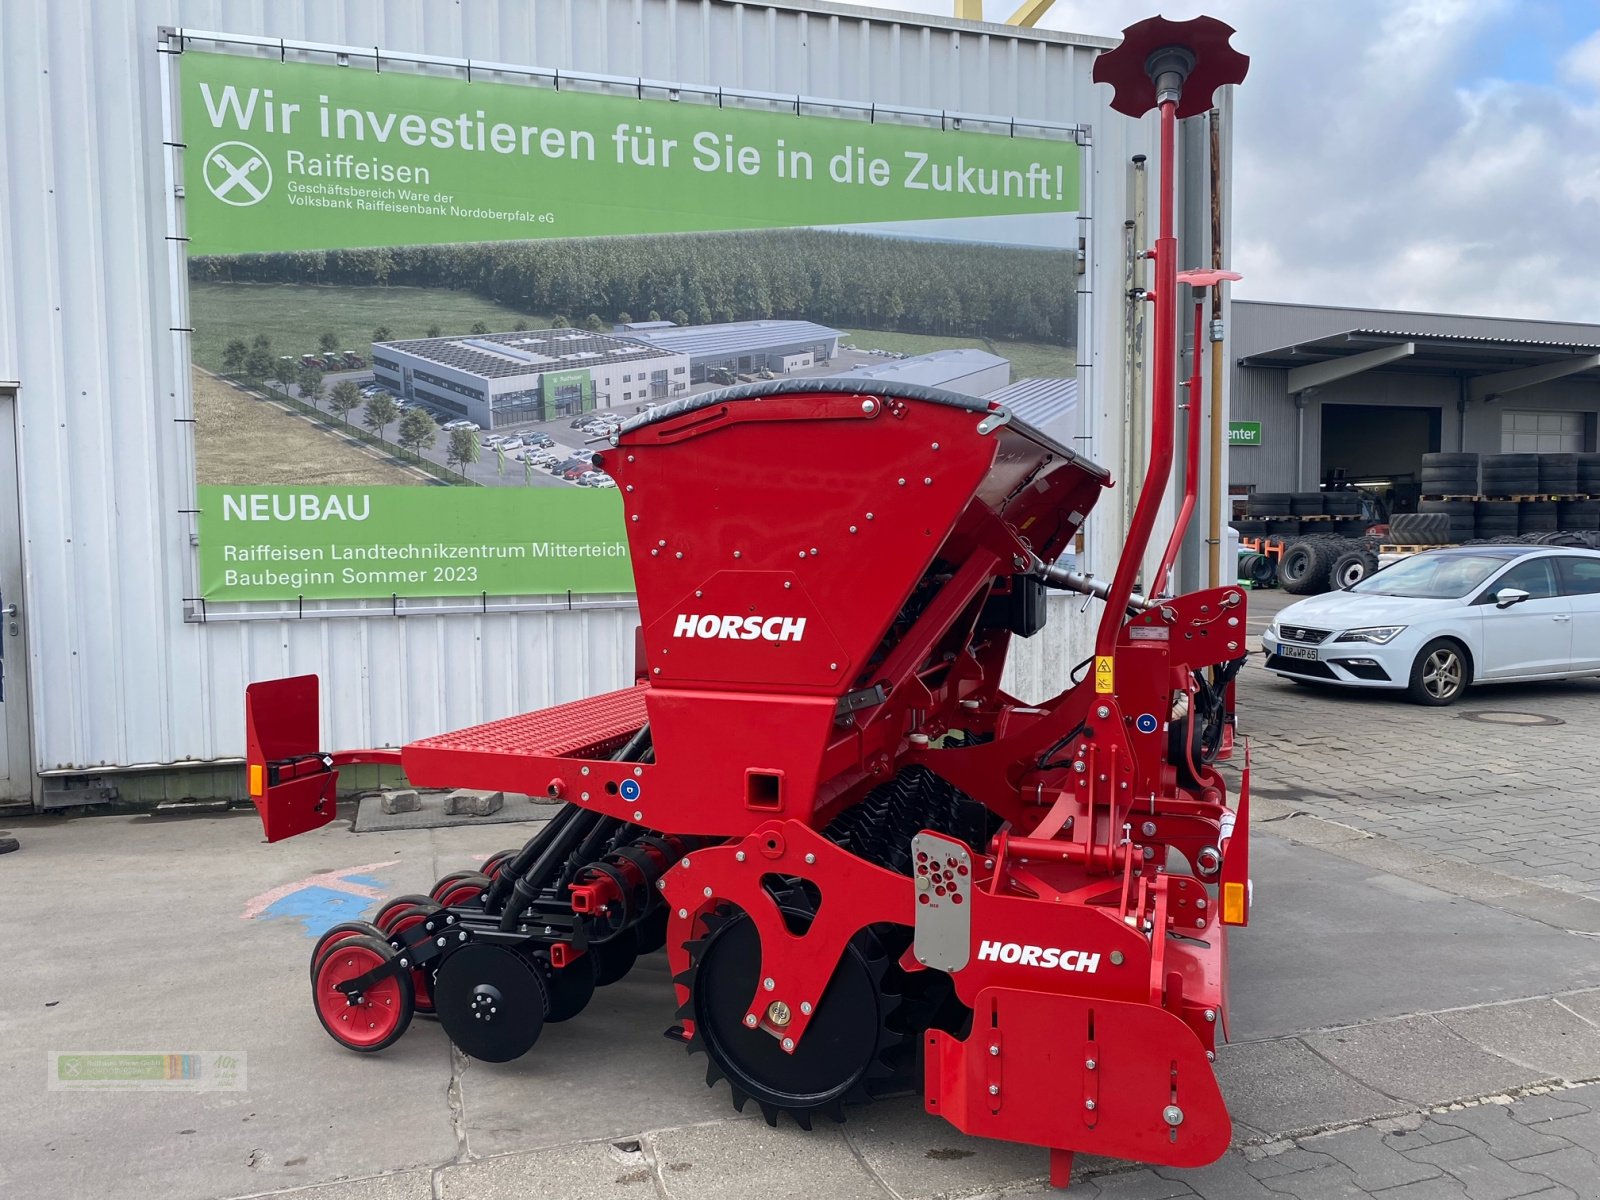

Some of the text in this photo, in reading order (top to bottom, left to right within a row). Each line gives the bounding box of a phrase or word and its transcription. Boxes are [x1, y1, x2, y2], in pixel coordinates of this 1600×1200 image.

[199, 82, 1063, 201] Wir investieren für Sie in die Zukunft!
[287, 149, 430, 185] Raiffeisen
[287, 180, 454, 204] Geschäftsbereich Ware der
[287, 193, 555, 224] Volksbank Raiffeisenbank Nordoberpfalz eG
[222, 494, 370, 521] NEUBAU
[224, 541, 626, 562] Raiffeisen Landtechnikzentrum Mitterteich
[225, 566, 478, 589] Baubeginn Sommer 2023
[673, 614, 807, 641] HORSCH
[978, 940, 1100, 973] HORSCH
